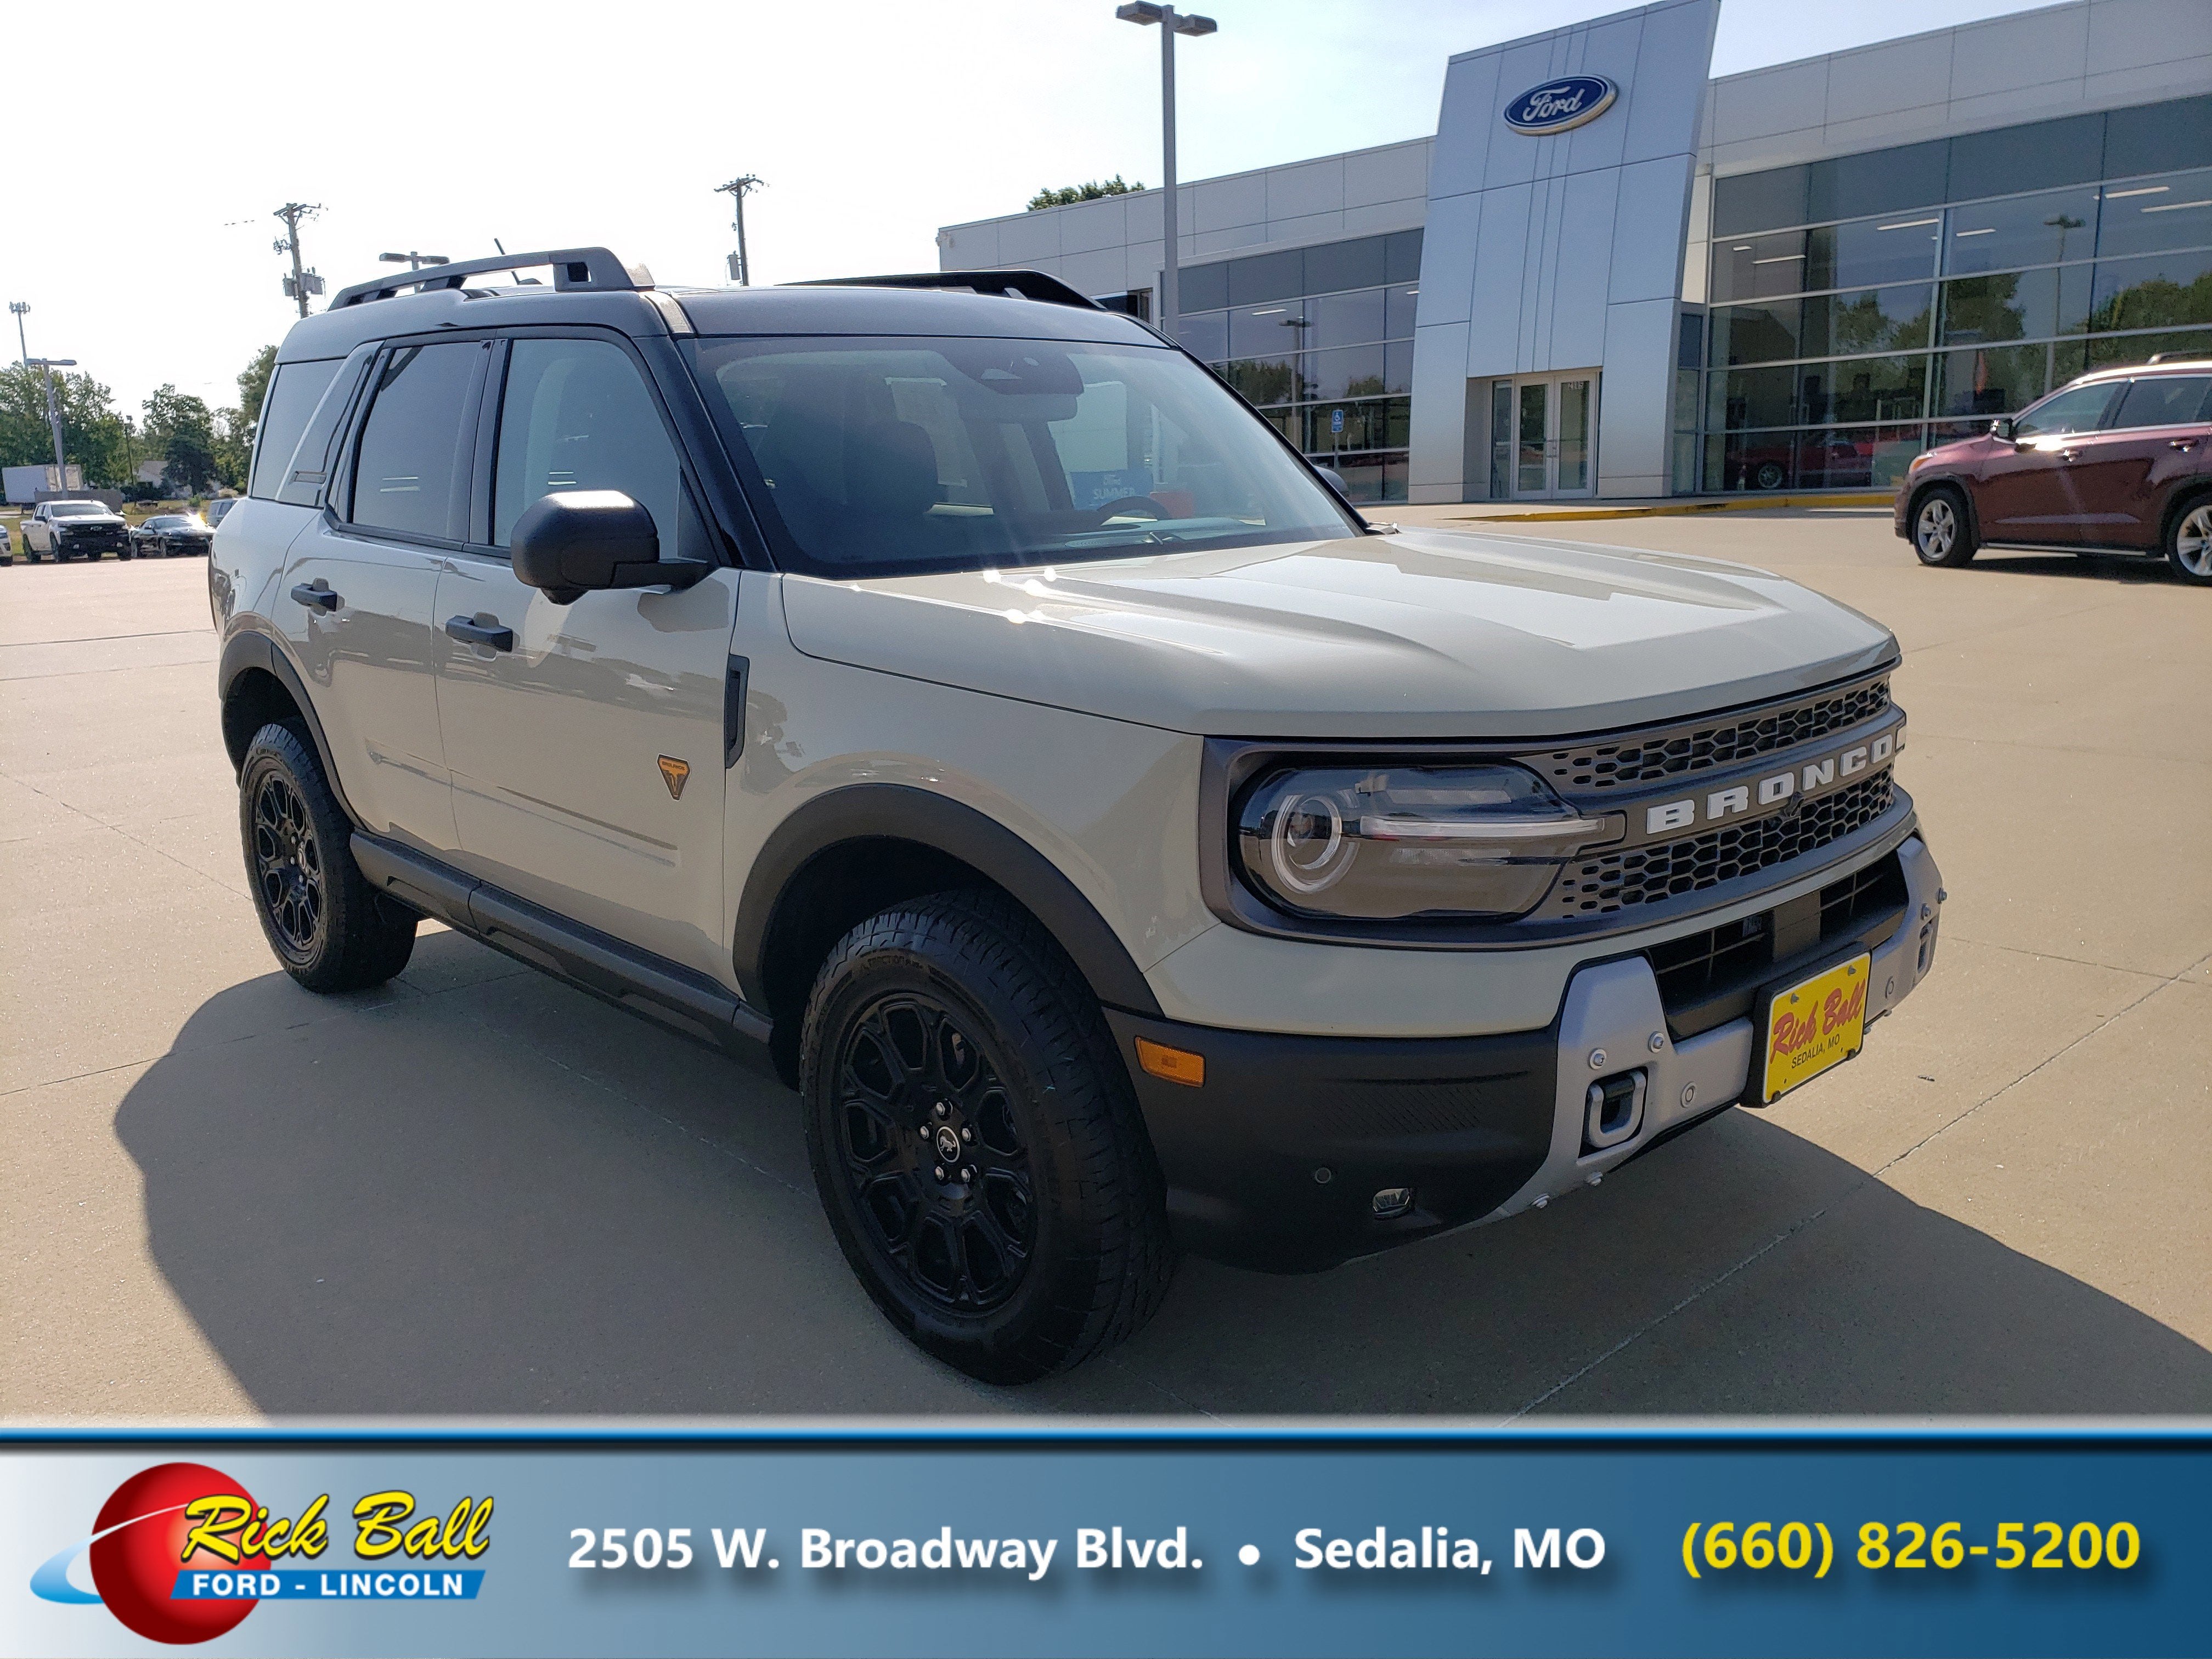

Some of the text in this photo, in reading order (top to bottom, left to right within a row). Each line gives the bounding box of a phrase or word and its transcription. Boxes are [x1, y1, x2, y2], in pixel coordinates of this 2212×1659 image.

[1522, 86, 1585, 122] Ford
[1646, 733, 1893, 834] BRONCO
[1770, 978, 1865, 1064] Rick Ball
[1791, 1033, 1841, 1069] SEDALIA, MO
